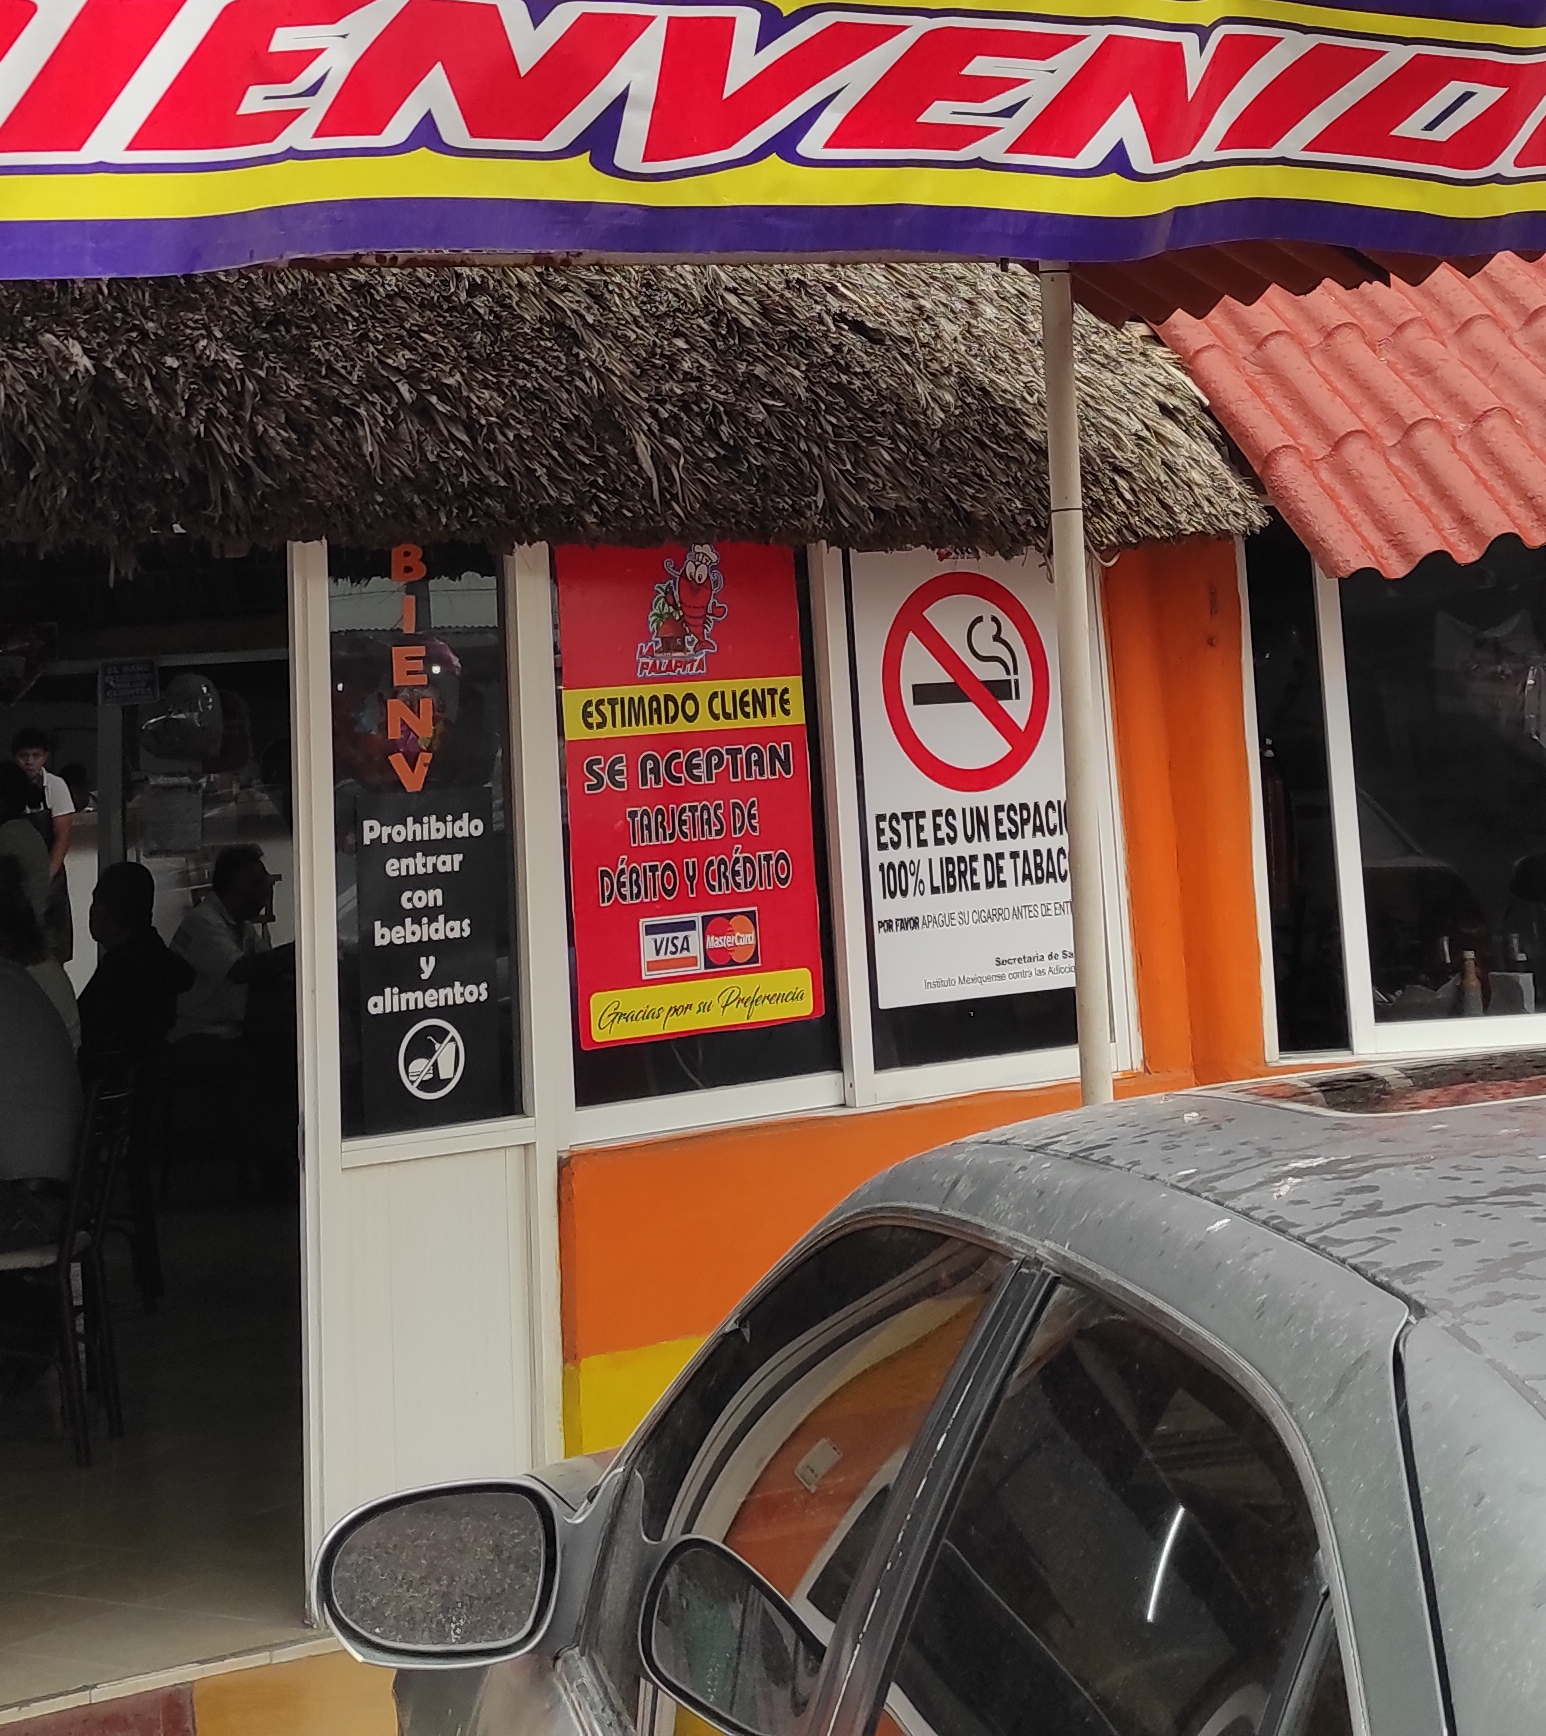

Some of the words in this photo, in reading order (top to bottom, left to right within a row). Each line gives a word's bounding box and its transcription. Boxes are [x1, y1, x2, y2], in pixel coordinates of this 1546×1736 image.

[639, 655, 705, 675] PALAPITA
[581, 692, 700, 730] ESTIMADO
[707, 687, 791, 721] CLIENTE
[584, 753, 627, 794] SE
[638, 742, 794, 789] ACEPTAN
[362, 812, 484, 845] Prohibido
[627, 800, 725, 847] TARJETAS
[730, 797, 760, 838] DE
[875, 810, 928, 852] ESTE
[931, 808, 958, 846] ES
[961, 805, 991, 844] UN
[993, 799, 1069, 841] ESPACI
[385, 851, 464, 877] entrar
[598, 855, 679, 907] DÉBITO
[684, 858, 698, 898] Y
[704, 844, 792, 895] CRÉDITO
[878, 858, 925, 900] 100%
[928, 854, 981, 895] LIBRE
[982, 851, 1007, 890] DE
[1009, 846, 1069, 888] TABAC
[400, 887, 443, 910] con
[374, 914, 471, 947] bebidas
[877, 919, 894, 934] POR
[895, 916, 920, 933] FAVOR
[921, 911, 957, 930] APAGUE
[957, 910, 970, 926] SU
[971, 906, 1010, 925] CIGARRO
[1012, 904, 1039, 921] ANTES
[1041, 902, 1052, 917] DE
[1054, 900, 1072, 916] ENT
[651, 934, 691, 957] VISA
[705, 931, 755, 949] MasterCard
[1047, 951, 1059, 961] de
[1061, 950, 1074, 959] Sa
[419, 956, 436, 980] y
[924, 976, 956, 990] Instituto
[957, 971, 1006, 987] Mexiquense
[1008, 968, 1032, 981] contra
[1034, 966, 1046, 977] las
[1047, 964, 1075, 976] Adiccio
[367, 981, 489, 1015] alimentos
[597, 999, 664, 1034] Gracias
[662, 1002, 692, 1030] por
[696, 1000, 714, 1014] su
[717, 984, 806, 1020] Preferencia
